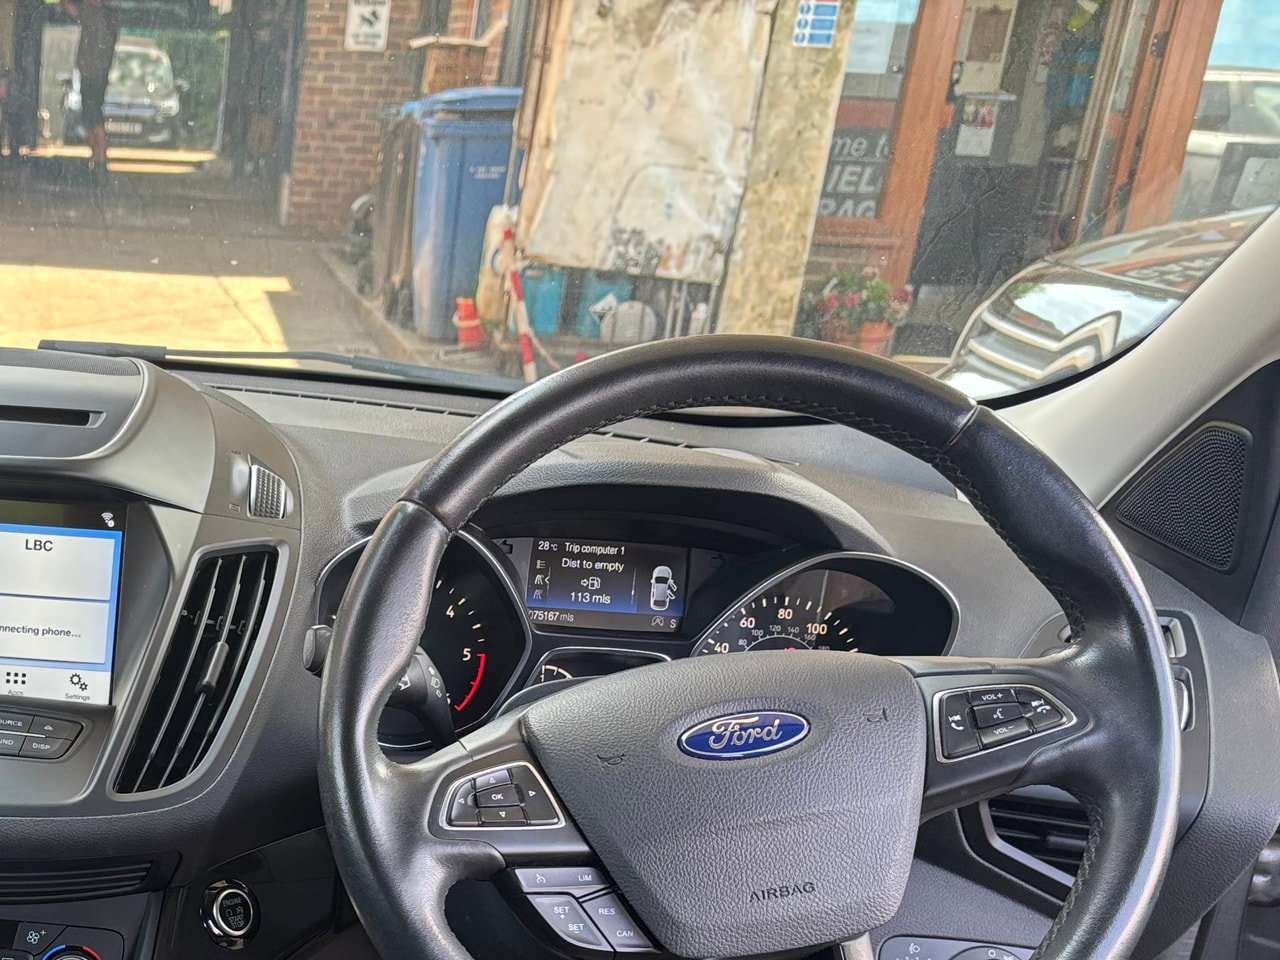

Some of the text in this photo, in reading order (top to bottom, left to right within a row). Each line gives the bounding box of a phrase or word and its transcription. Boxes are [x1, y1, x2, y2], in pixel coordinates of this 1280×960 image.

[25, 538, 54, 552] LBC
[565, 542, 579, 553] Trip
[581, 545, 619, 555] computer
[620, 546, 625, 555] 1
[562, 557, 624, 573] Dist to empty
[570, 592, 590, 603] 113
[446, 605, 455, 619] 4
[777, 608, 793, 620] 80
[739, 617, 755, 629] 60
[751, 629, 764, 637] 100
[787, 626, 800, 634] 140
[806, 623, 827, 635] 100
[804, 633, 817, 641] 160
[738, 638, 748, 647] 80
[714, 643, 729, 654] 40
[462, 648, 471, 661] 5
[8, 689, 24, 697] Apps
[65, 692, 90, 701] Settings
[708, 716, 782, 750] Ford
[32, 742, 51, 751] DISP
[491, 792, 504, 801] OK
[578, 874, 592, 882] LIM
[749, 881, 816, 903] AIRBAG
[554, 906, 569, 914] SET
[598, 908, 616, 916] RES
[568, 923, 584, 931] SET
[616, 929, 634, 937] CAN
